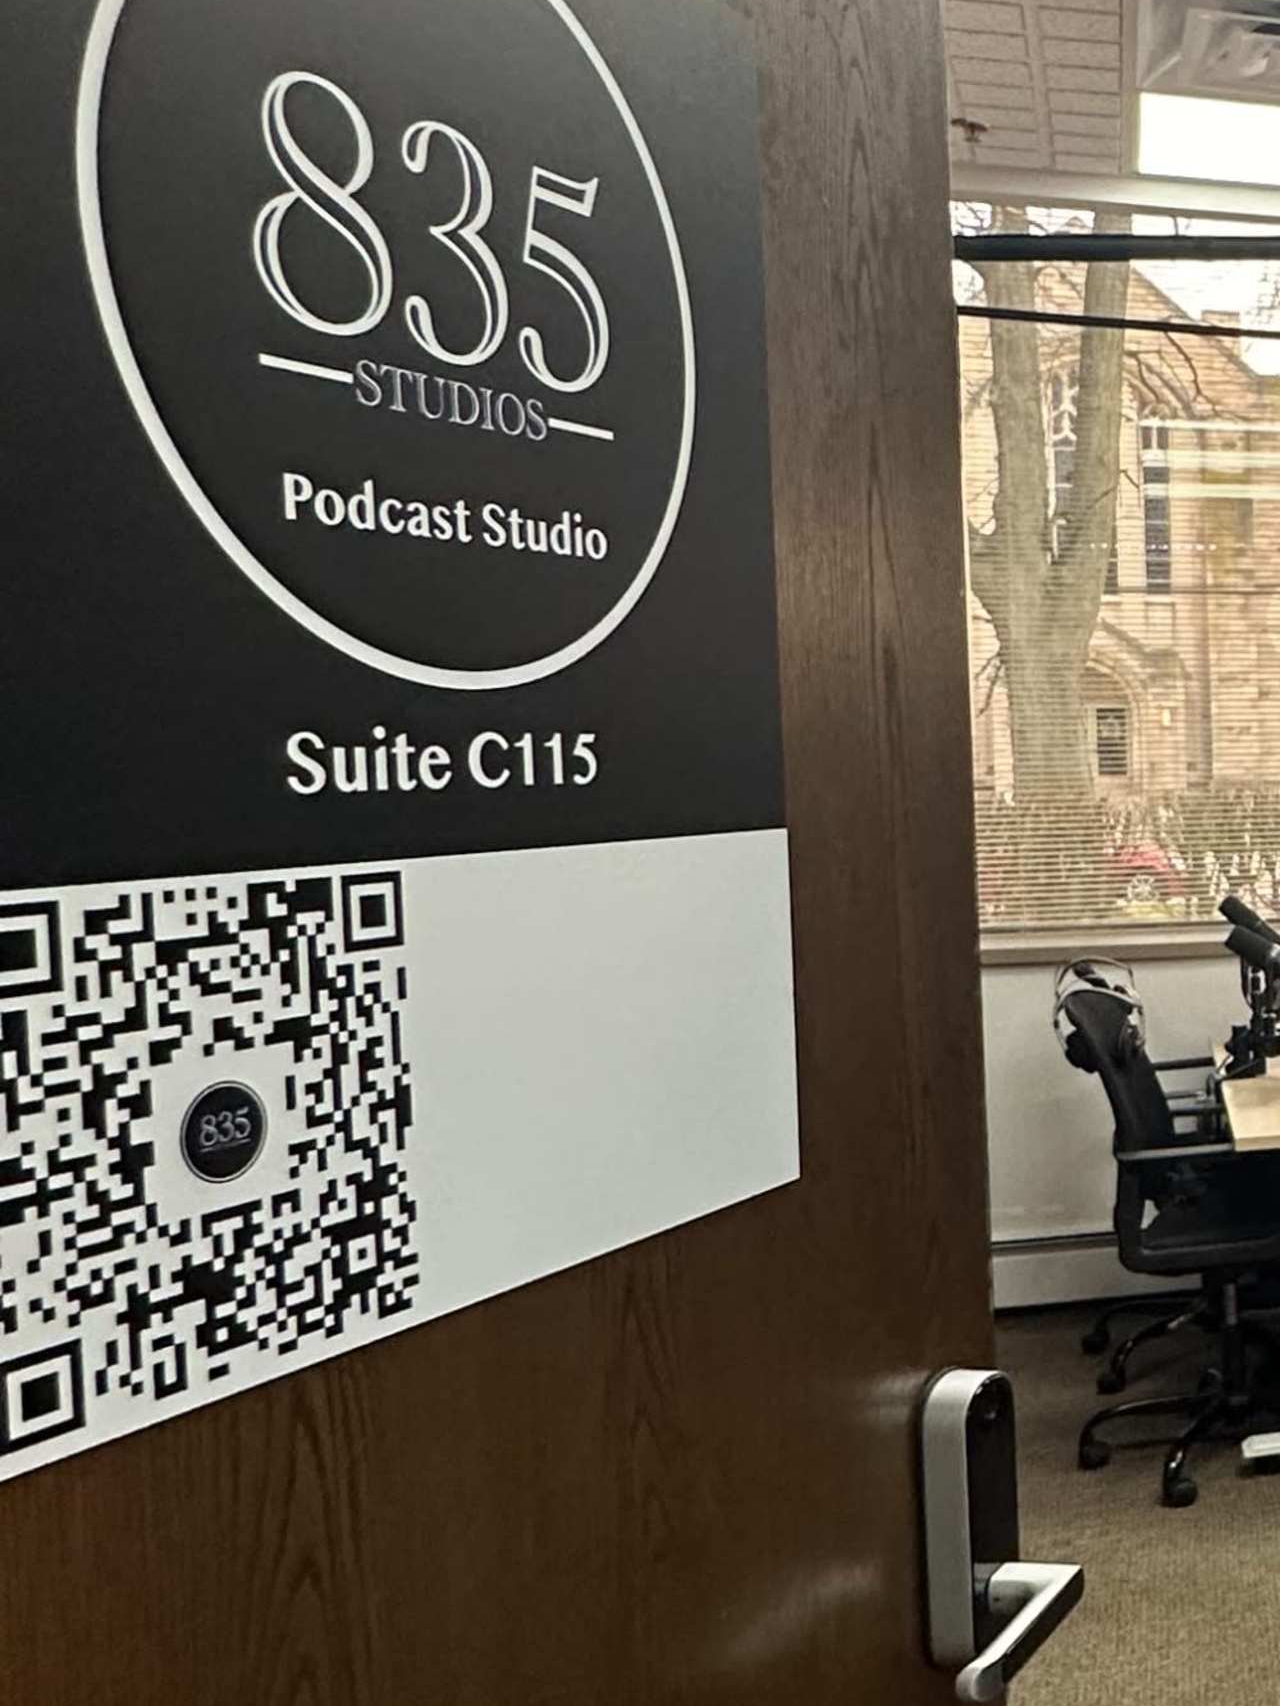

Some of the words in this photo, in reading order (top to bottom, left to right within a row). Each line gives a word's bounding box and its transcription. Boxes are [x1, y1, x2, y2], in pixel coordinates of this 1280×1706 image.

[253, 70, 610, 393] 835
[354, 359, 549, 443] STUDIOS
[282, 472, 471, 545] Podcast
[481, 505, 608, 560] Studio
[286, 725, 453, 795] Suite
[468, 731, 598, 789] C115
[201, 1106, 252, 1145] 835
